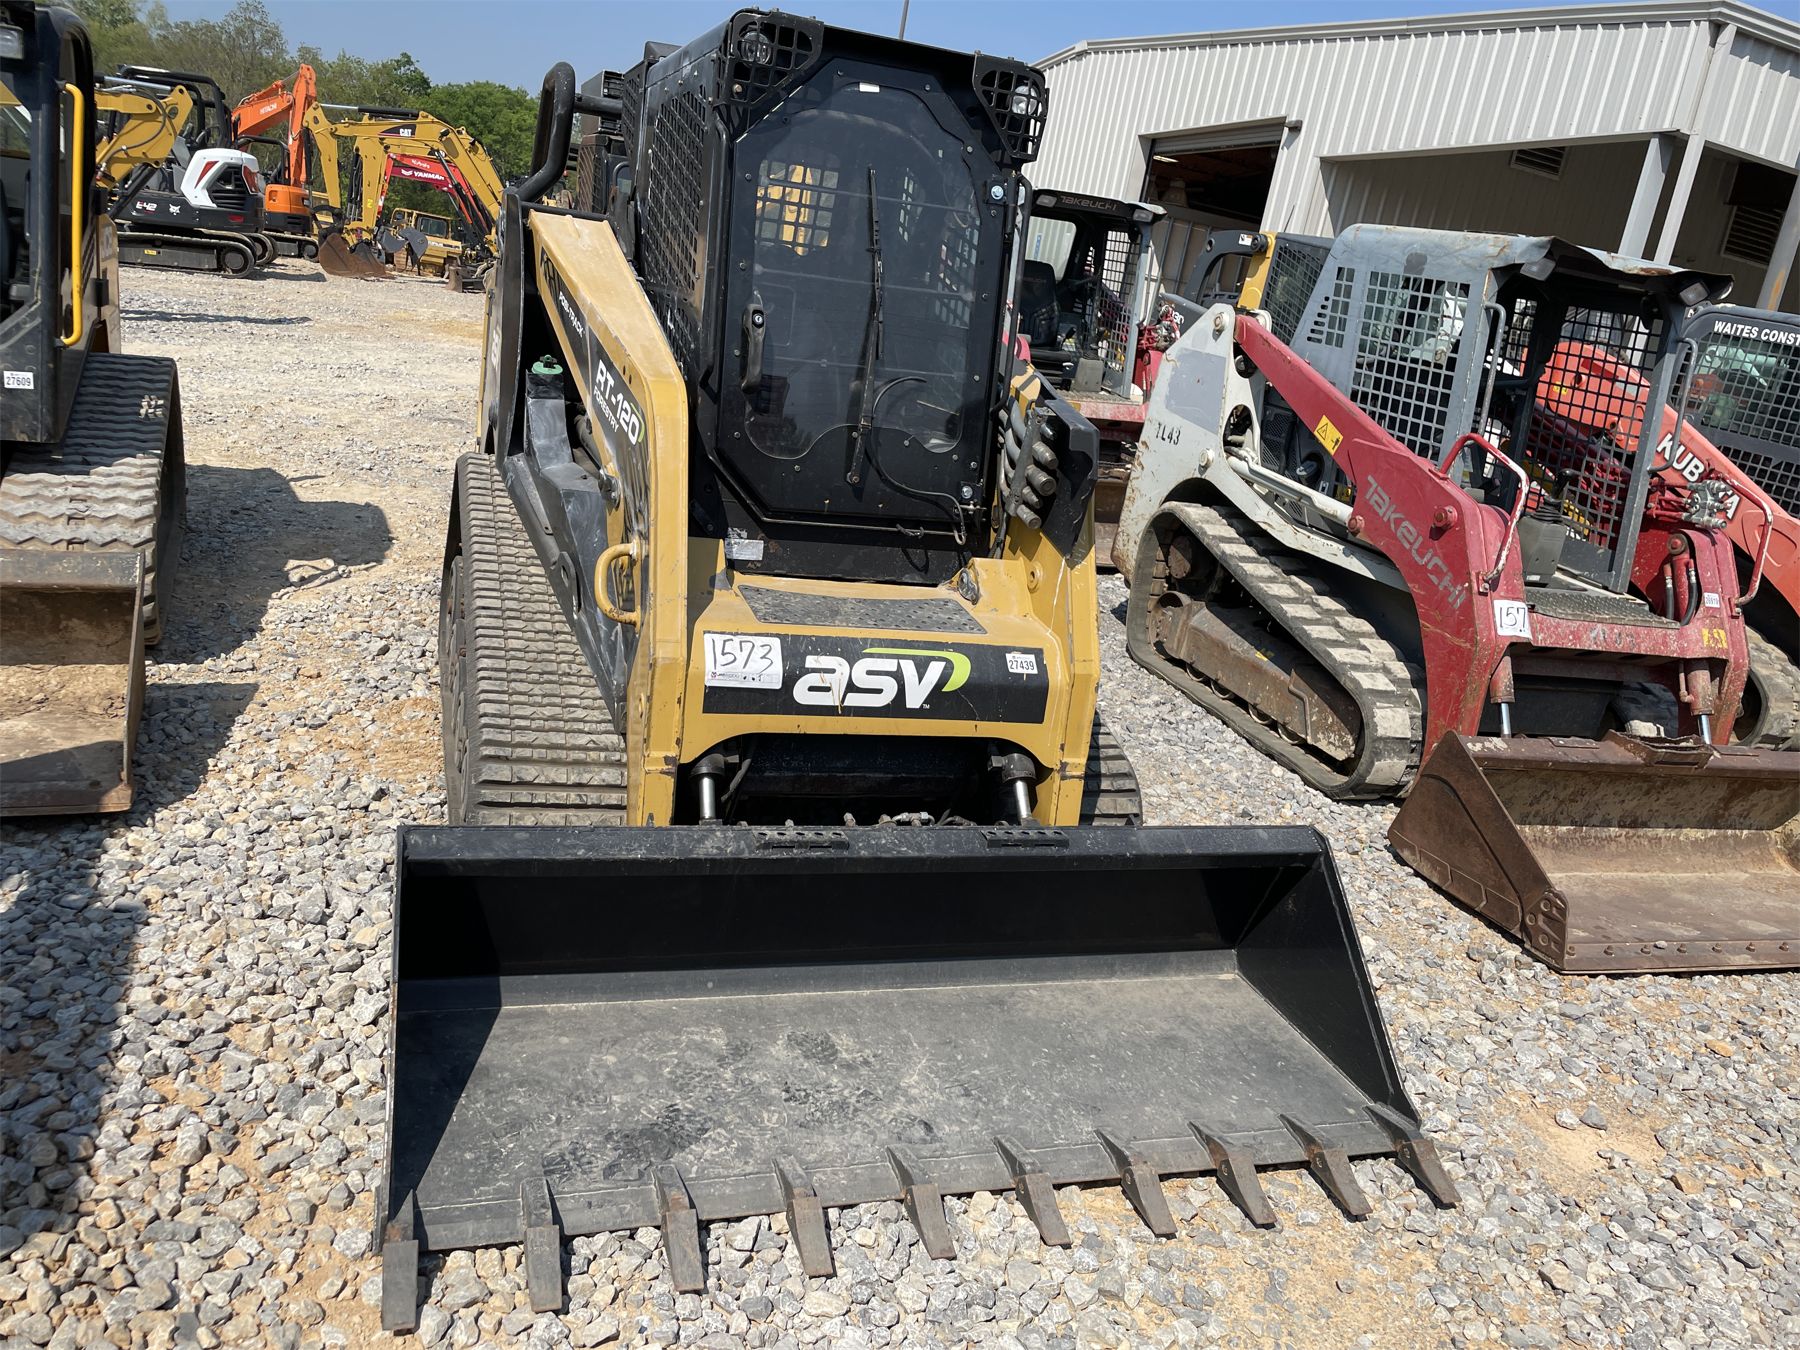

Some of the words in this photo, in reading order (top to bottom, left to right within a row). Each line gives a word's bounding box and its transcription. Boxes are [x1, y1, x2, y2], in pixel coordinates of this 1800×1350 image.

[399, 128, 412, 137] CAT
[413, 170, 445, 181] YANMAR
[1713, 320, 1759, 339] WAITES
[6, 376, 31, 387] 27609
[593, 385, 619, 433] FORESTRY
[596, 359, 640, 446] RT-120
[711, 638, 774, 674] 1573
[1008, 659, 1035, 671] 27439
